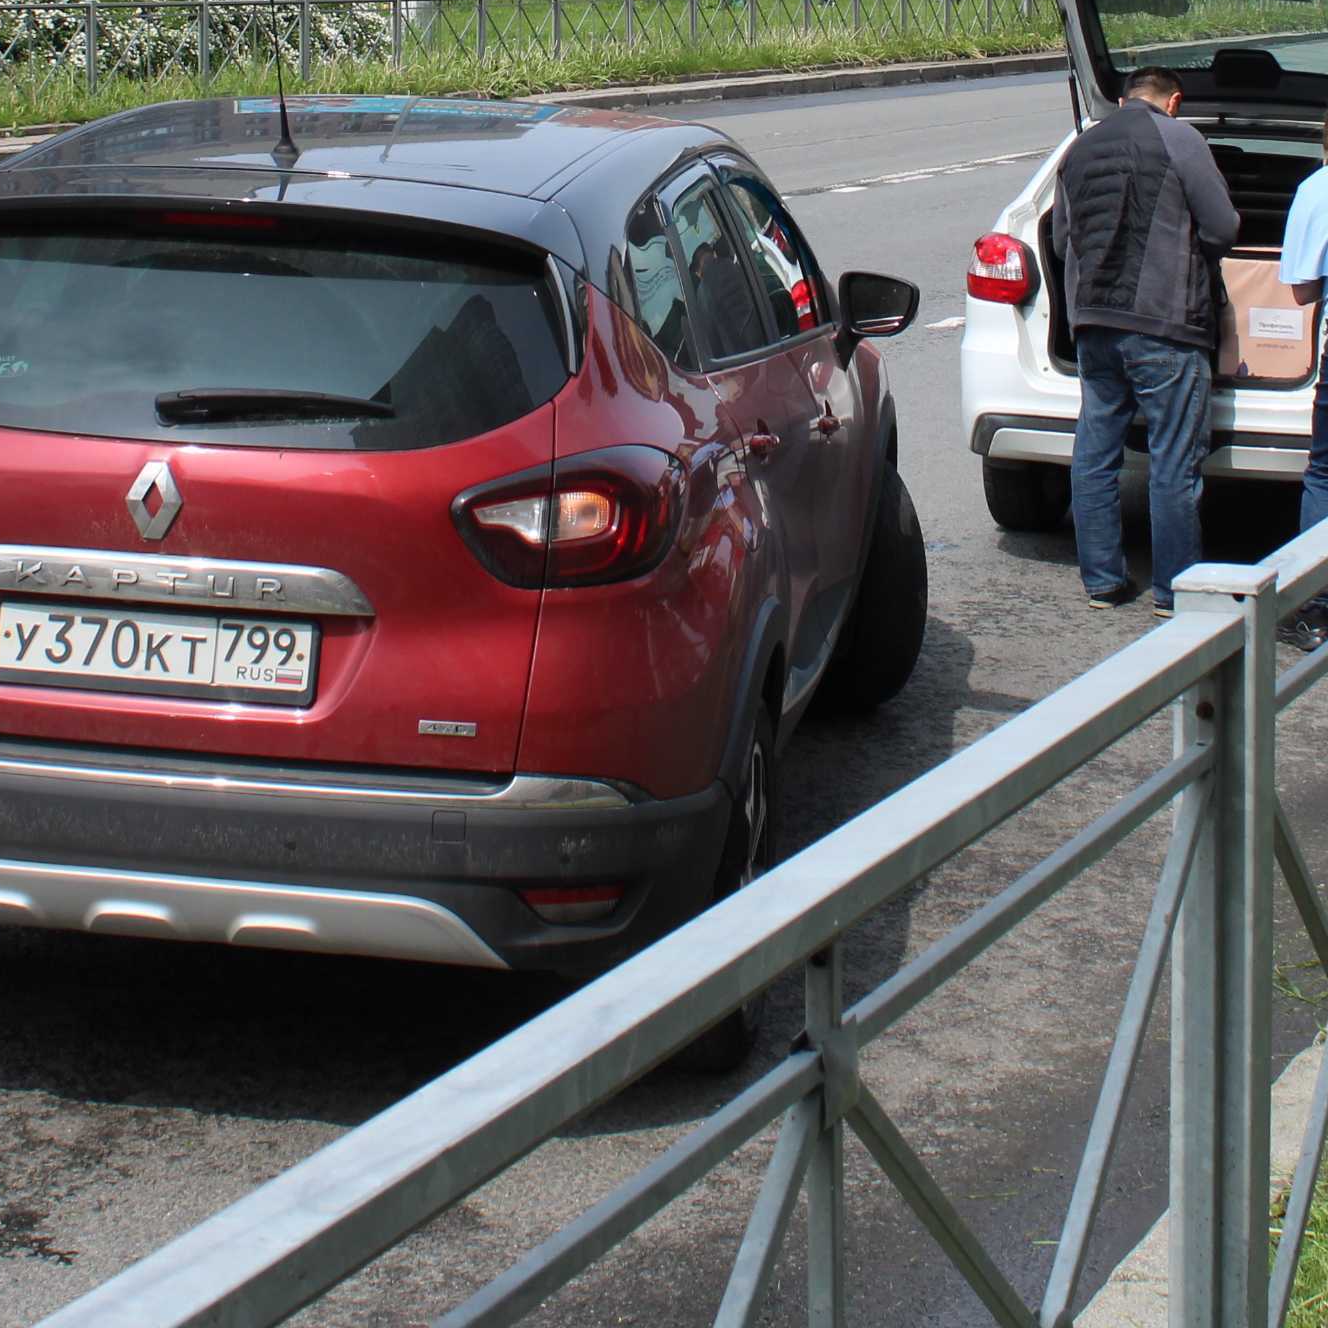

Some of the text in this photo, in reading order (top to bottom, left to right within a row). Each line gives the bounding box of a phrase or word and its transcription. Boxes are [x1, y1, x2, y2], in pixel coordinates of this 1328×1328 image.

[15, 559, 287, 602] KAPTUR
[16, 614, 297, 674] У370КТ 799
[237, 666, 274, 683] RUS
